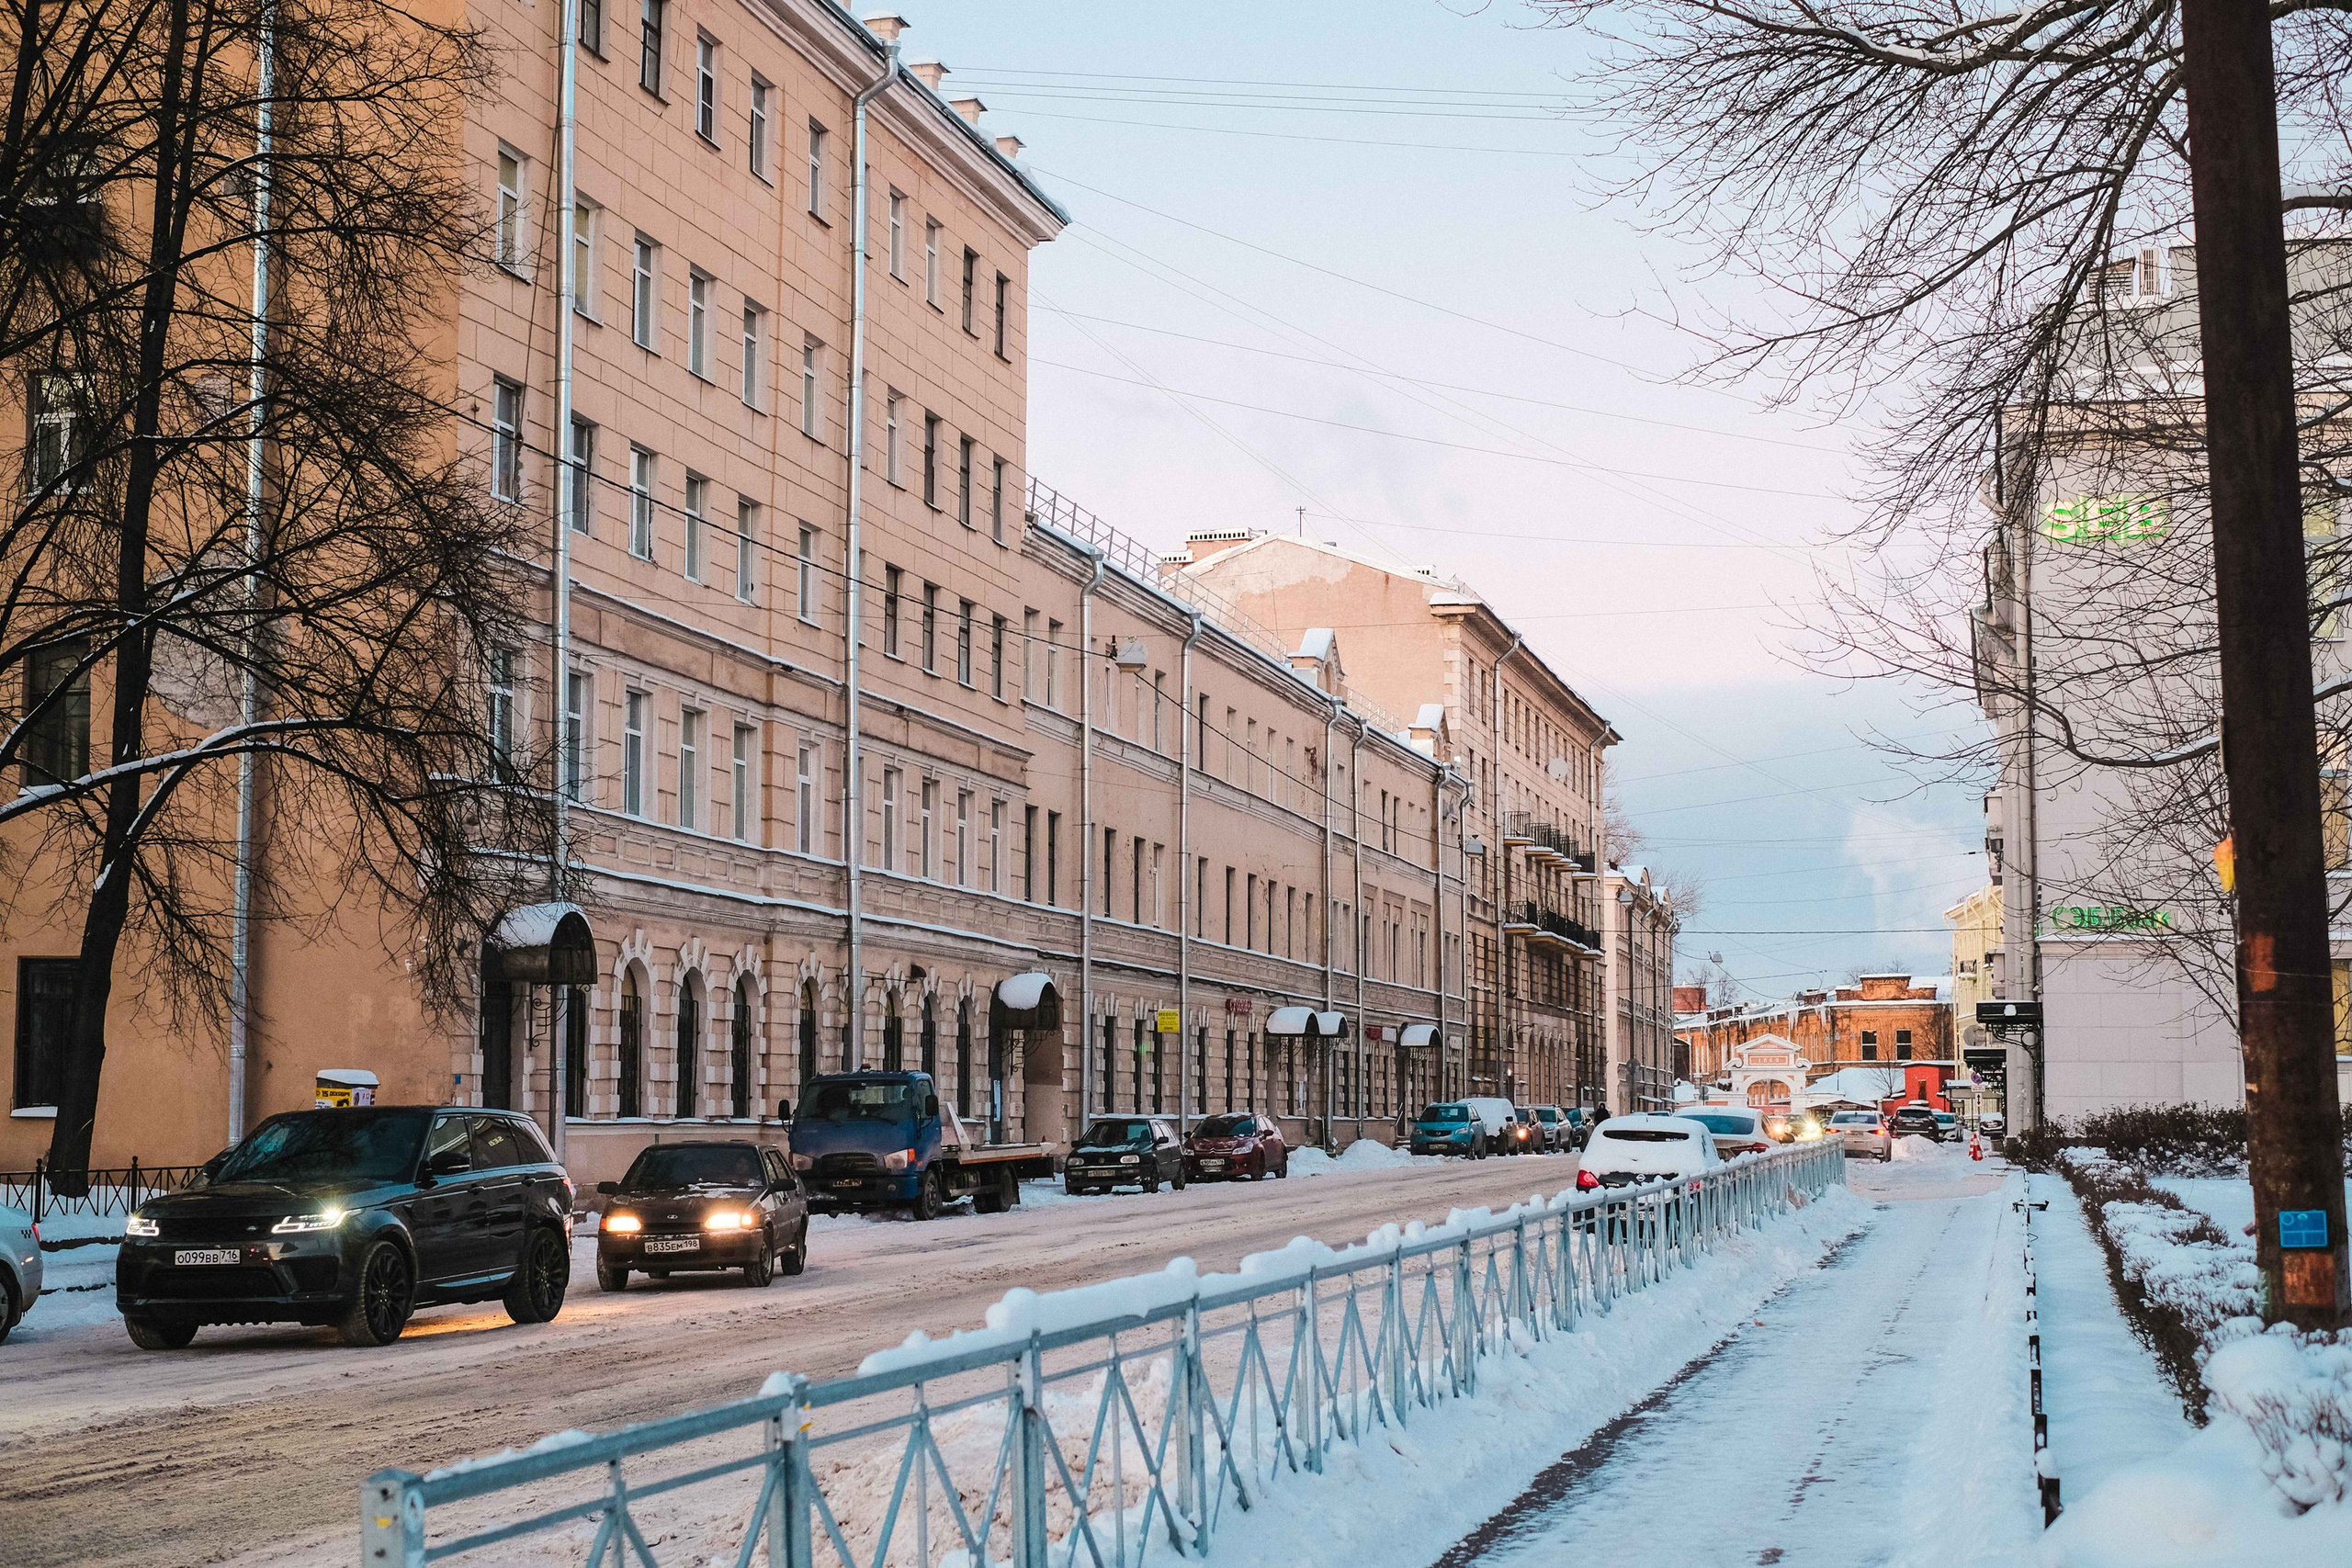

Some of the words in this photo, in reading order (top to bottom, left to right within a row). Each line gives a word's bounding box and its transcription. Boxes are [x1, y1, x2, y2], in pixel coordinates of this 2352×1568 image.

[2042, 499, 2166, 540] SEB
[177, 1251, 219, 1264] О099ВВ
[220, 1250, 238, 1259] 716
